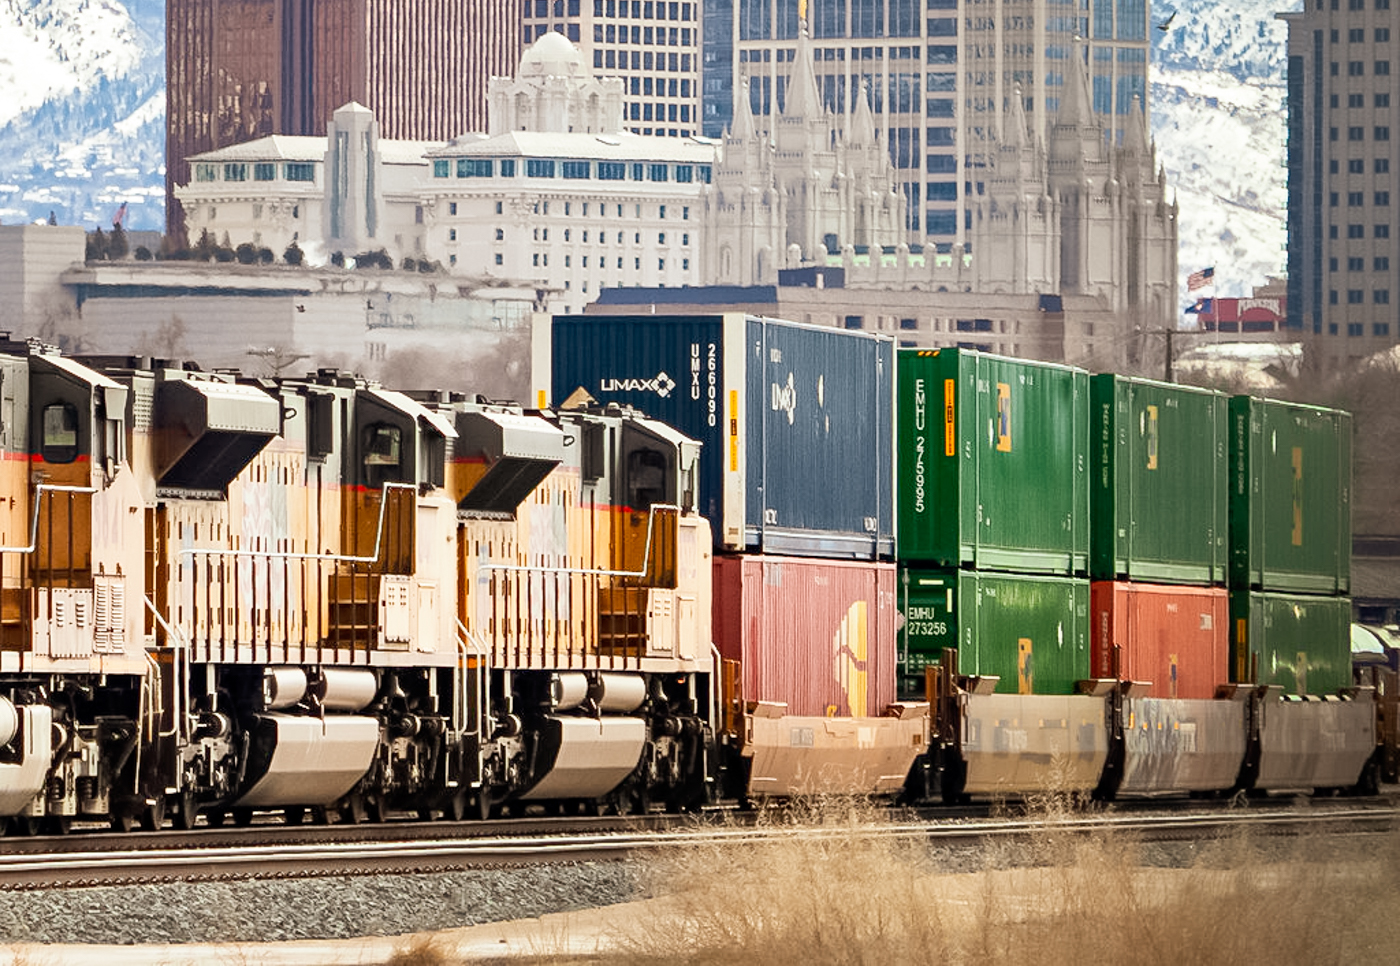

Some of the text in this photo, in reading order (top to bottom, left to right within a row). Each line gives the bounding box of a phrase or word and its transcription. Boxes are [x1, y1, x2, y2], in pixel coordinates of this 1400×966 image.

[601, 378, 655, 391] UMAX
[691, 343, 700, 400] UMXU
[707, 343, 717, 427] 266090
[915, 379, 925, 513] EMHU 275995
[908, 607, 935, 620] EMHU
[908, 622, 947, 636] 273256
